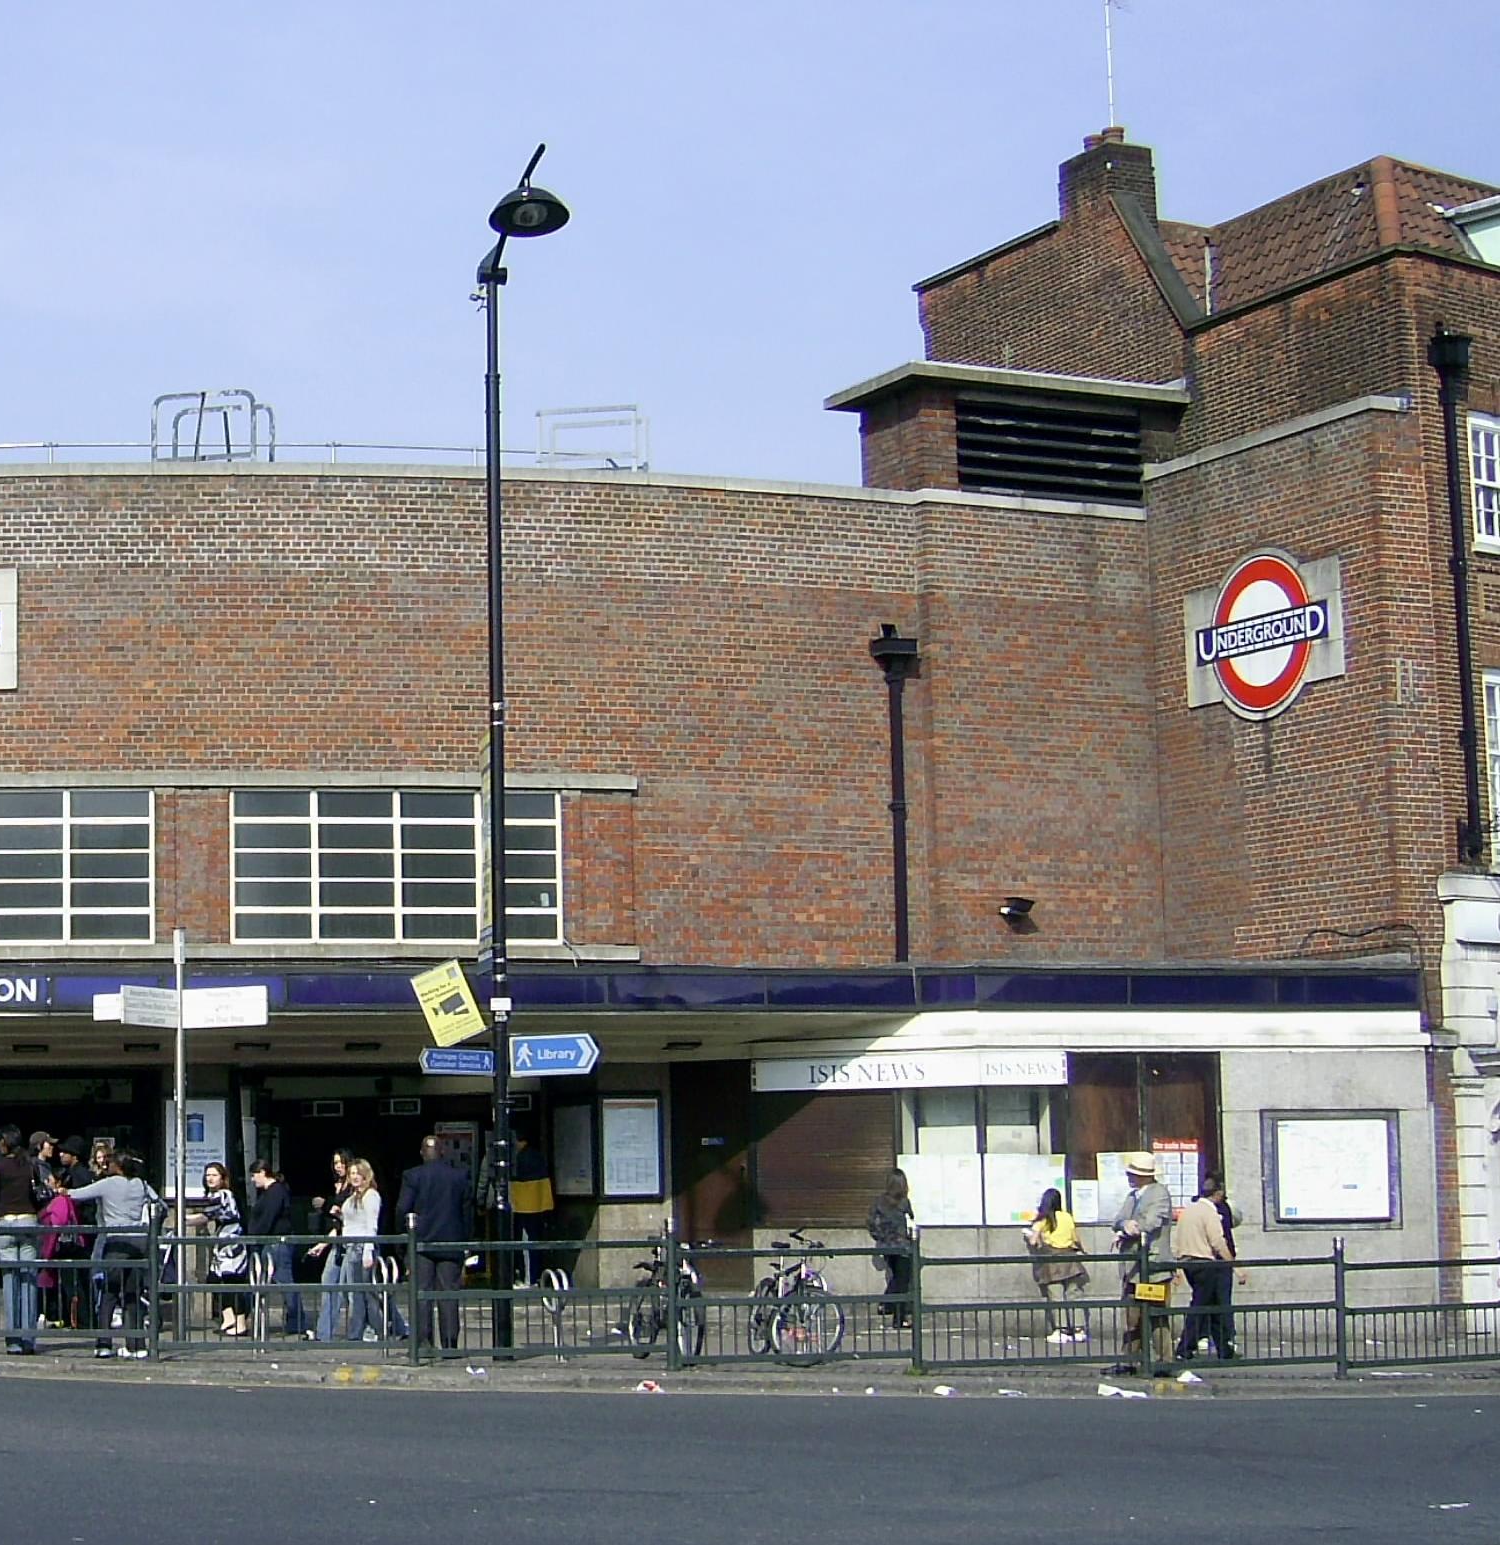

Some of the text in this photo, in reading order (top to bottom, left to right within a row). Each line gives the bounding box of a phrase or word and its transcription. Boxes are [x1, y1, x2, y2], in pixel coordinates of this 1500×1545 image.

[1199, 605, 1325, 661] UNDERGROUND
[537, 1048, 576, 1061] Library
[809, 1063, 925, 1084] ISIS NEWS
[985, 1061, 1058, 1076] ISIS NEWS
